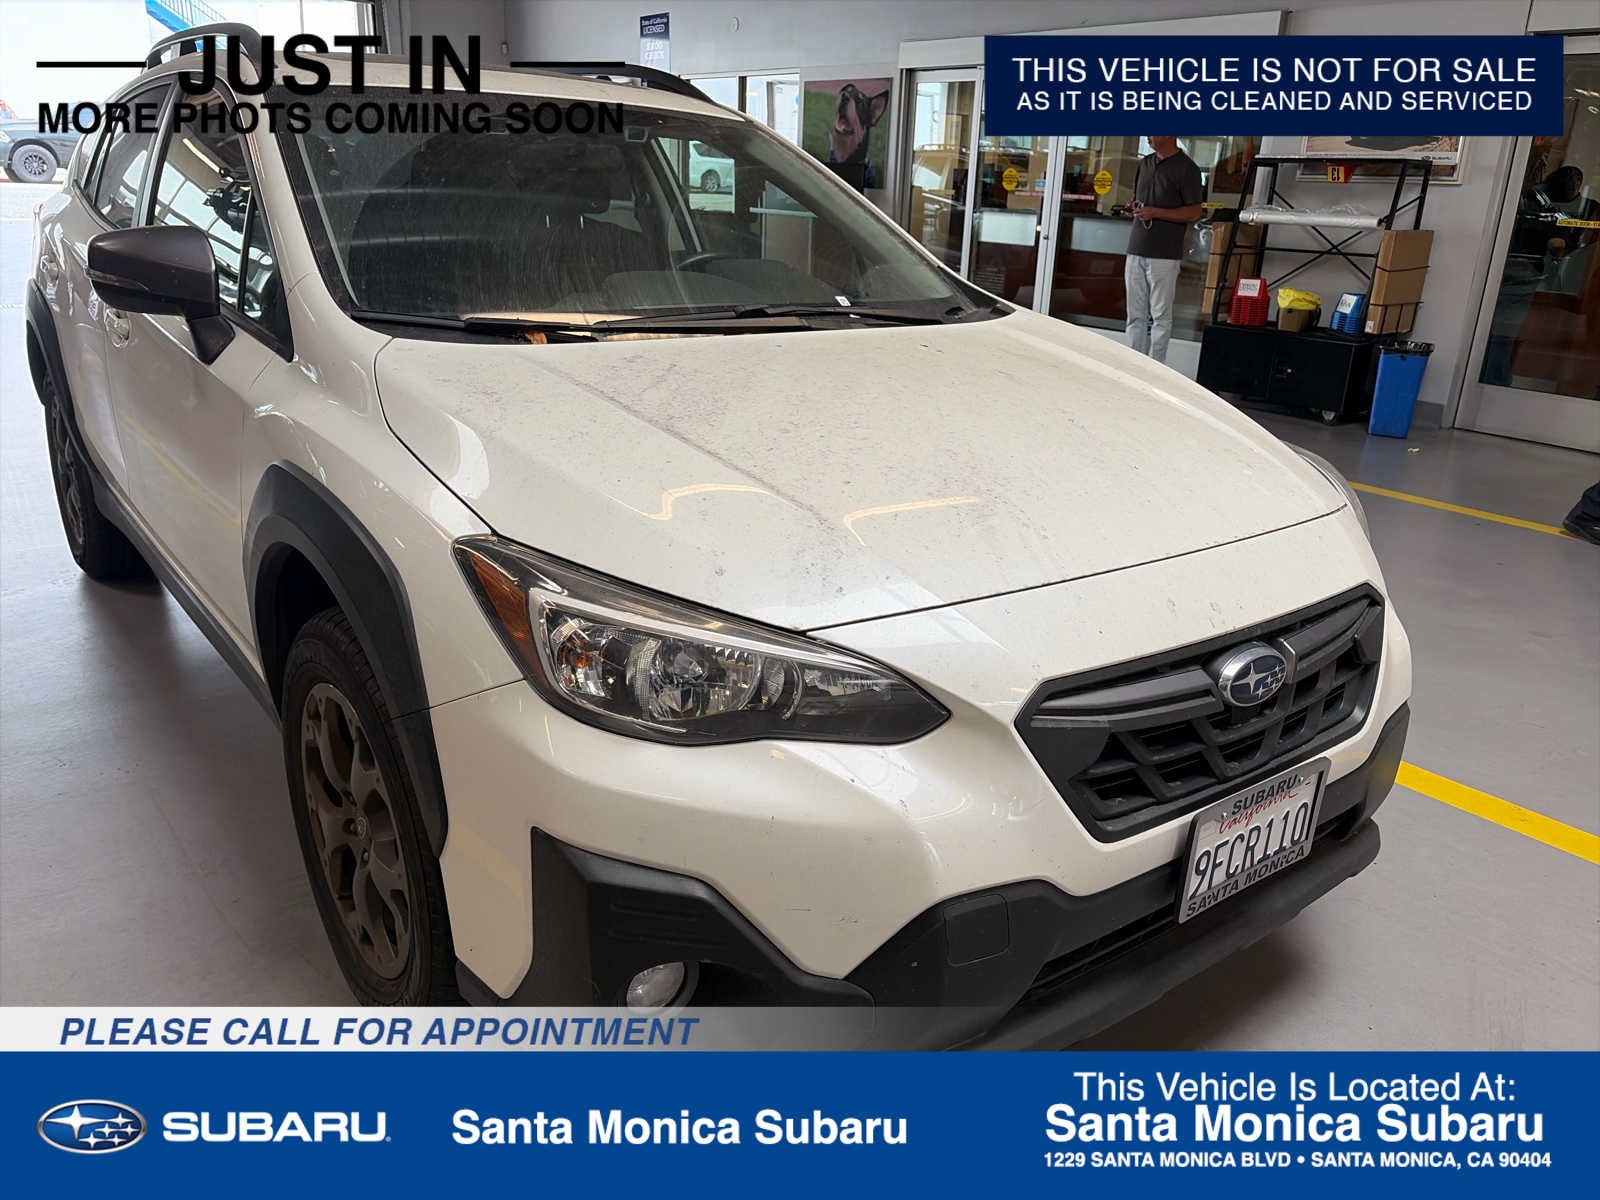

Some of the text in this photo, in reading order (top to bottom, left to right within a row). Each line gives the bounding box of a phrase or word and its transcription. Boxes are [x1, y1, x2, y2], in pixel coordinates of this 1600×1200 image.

[1231, 774, 1298, 815] SUBARU
[1186, 845, 1305, 918] SANTA MONICA
[1187, 801, 1309, 901] 9FCR110
